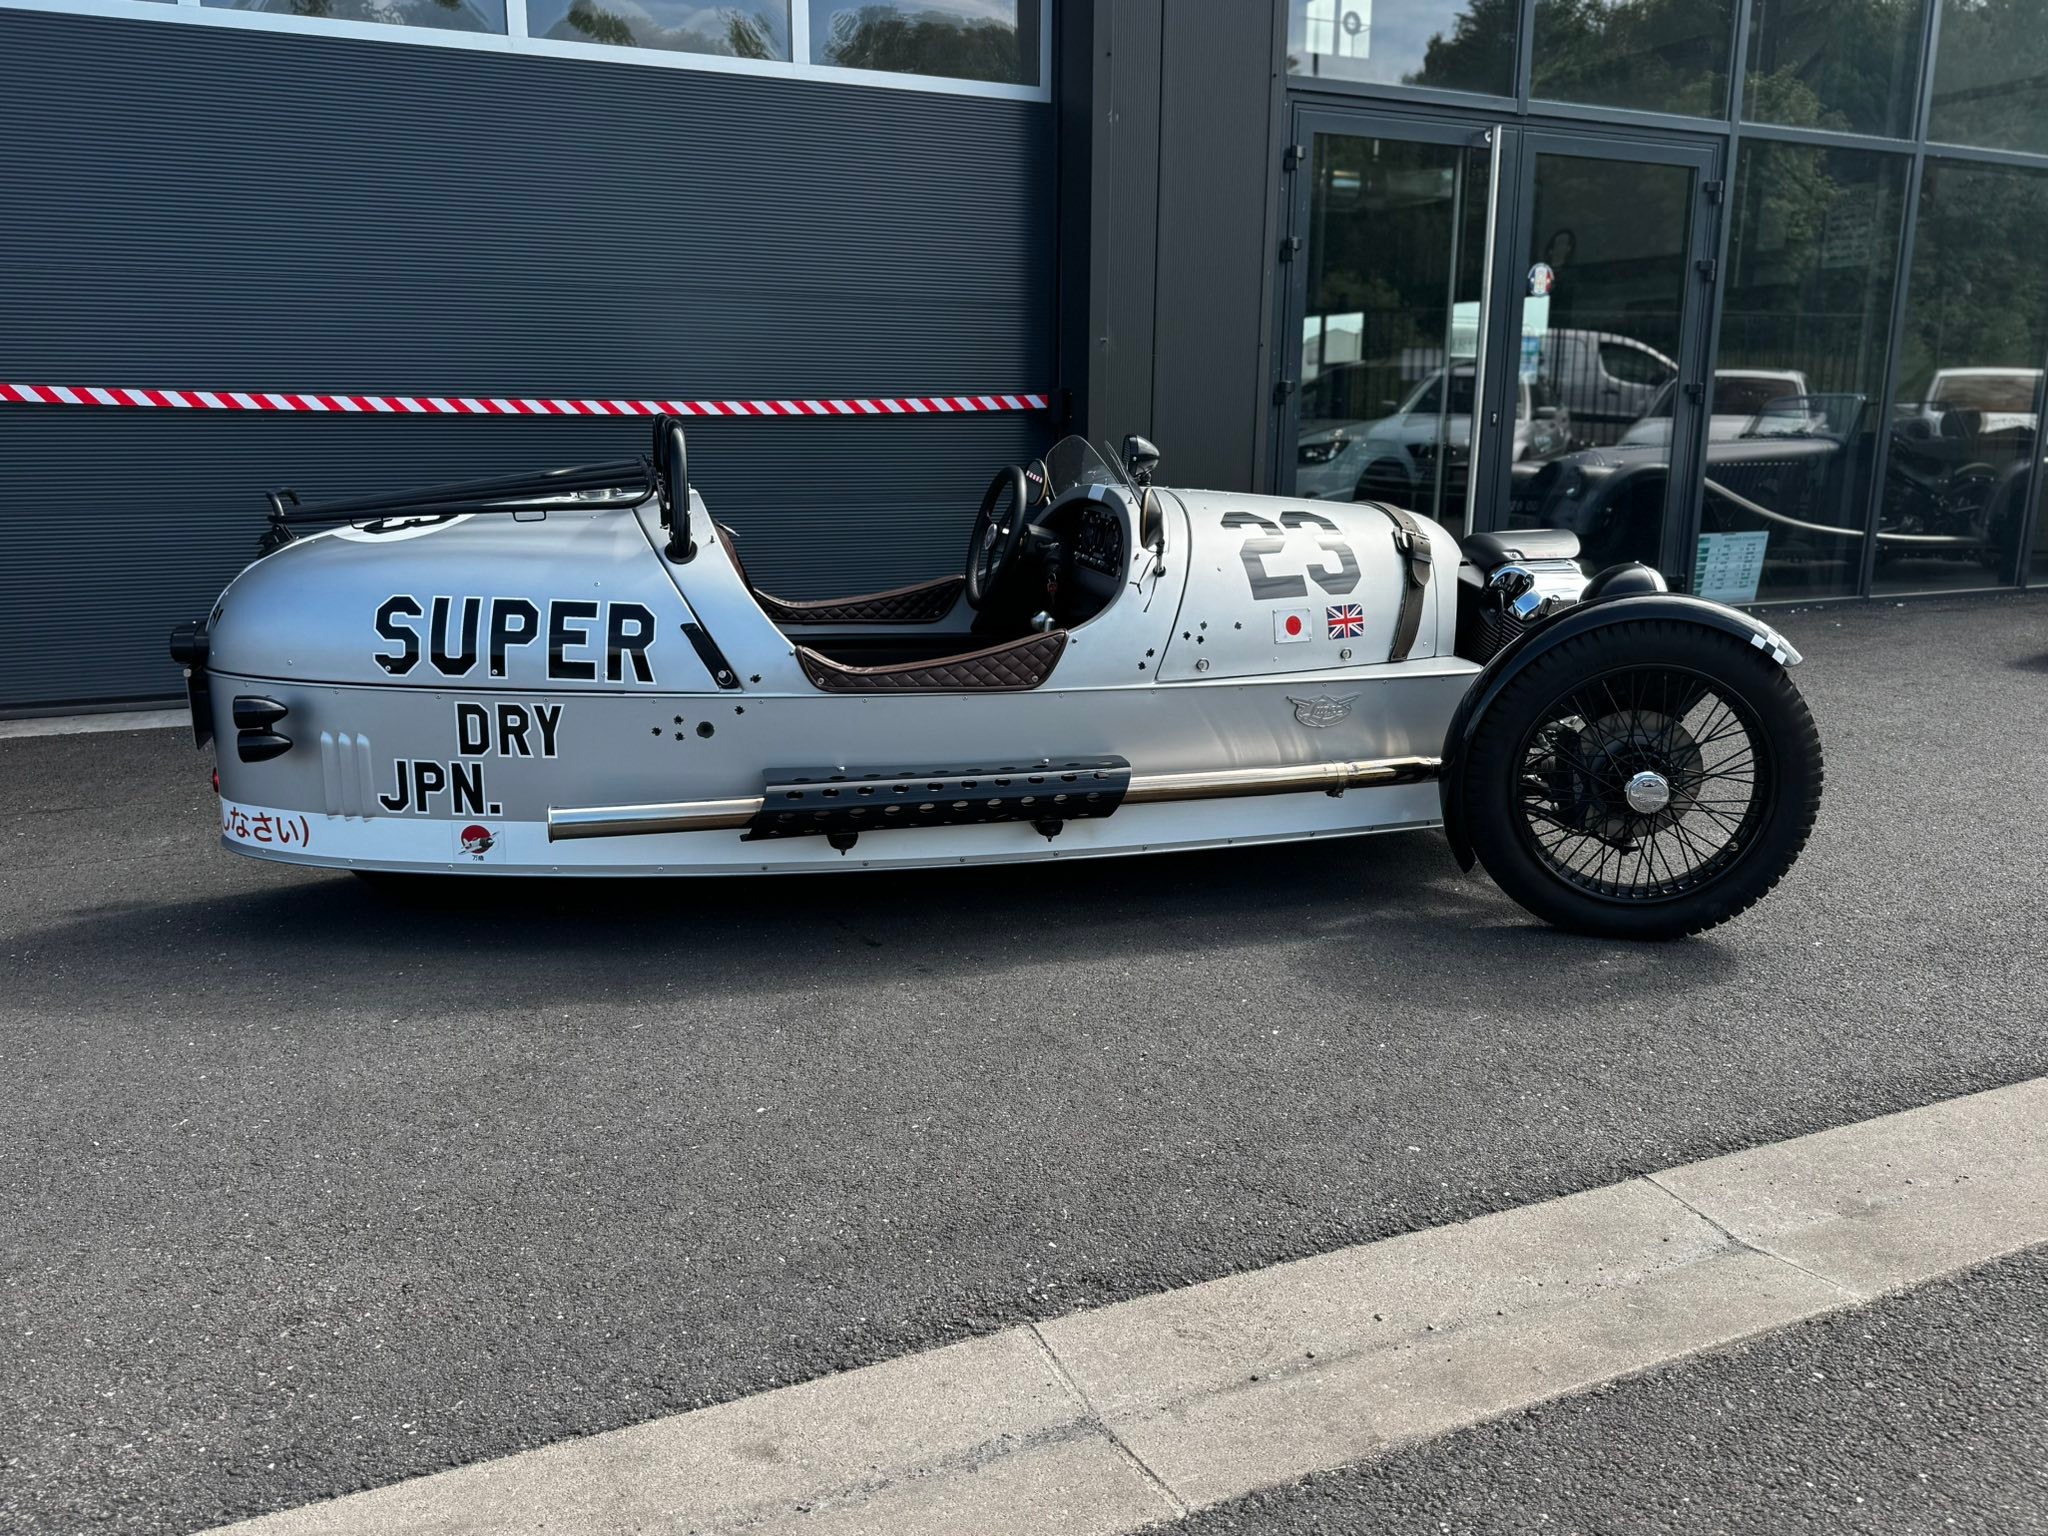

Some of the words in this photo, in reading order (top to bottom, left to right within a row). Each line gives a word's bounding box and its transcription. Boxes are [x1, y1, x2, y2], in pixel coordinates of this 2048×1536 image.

[1220, 511, 1361, 601] 23
[372, 595, 657, 685] SUPER
[454, 702, 565, 759] DRY
[378, 759, 504, 816] JPN.
